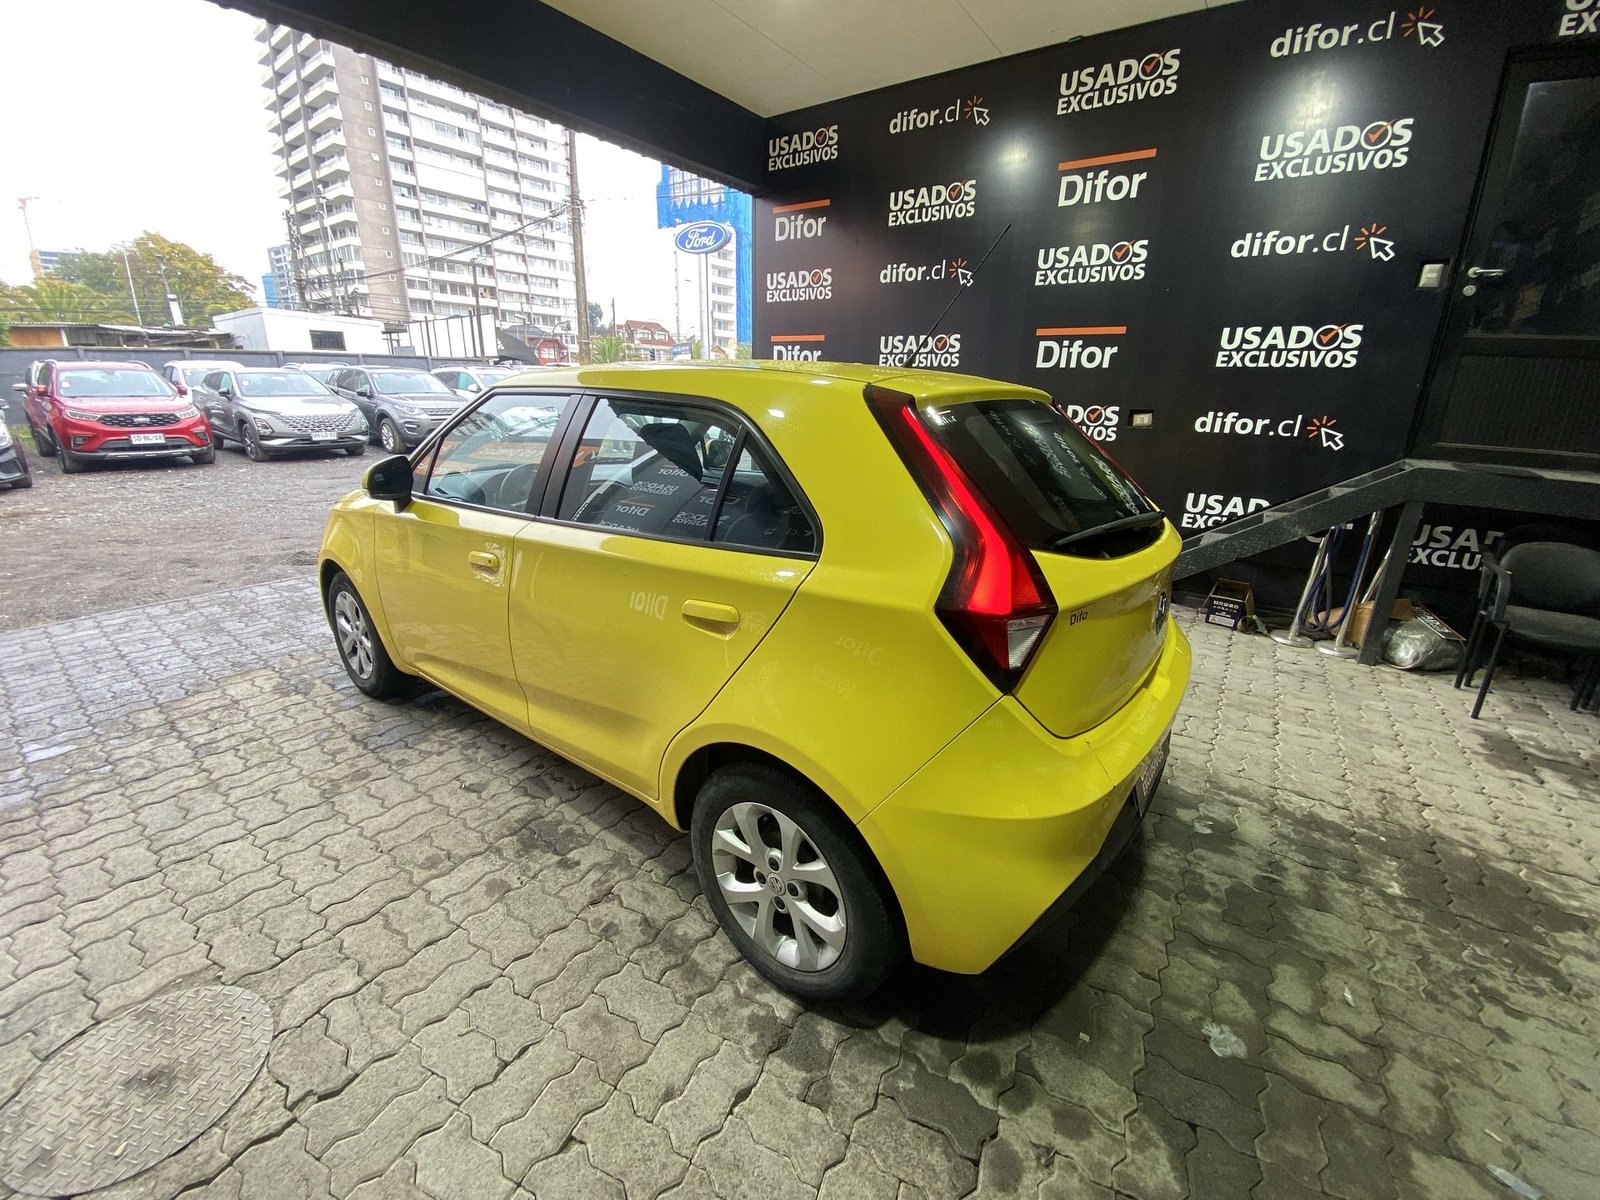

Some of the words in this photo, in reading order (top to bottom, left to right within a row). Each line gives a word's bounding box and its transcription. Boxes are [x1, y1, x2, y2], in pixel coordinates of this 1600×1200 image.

[1269, 11, 1397, 58] difor.cl
[1058, 48, 1181, 96] USADOS
[1056, 74, 1178, 116] EXCLUSIVOS
[888, 99, 961, 134] difor.cl
[768, 125, 838, 157] USADOS
[1258, 118, 1415, 161] USADOS
[768, 144, 838, 171] EXCLUSIVOS
[1254, 147, 1409, 182] EXCLUSIVOS
[889, 179, 976, 212] USADOS
[1057, 169, 1147, 207] Difor
[888, 201, 975, 227] EXCLUSIVOS
[685, 227, 715, 249] Ford
[774, 214, 827, 242] Difor
[1230, 225, 1350, 258] difor.cl
[1037, 239, 1149, 269] USADOS
[766, 267, 833, 290] USADOS
[879, 259, 947, 284] difor.cl
[1034, 263, 1146, 286] EXCLUSIVOS
[766, 285, 832, 303] EXCLUSIVOS
[879, 333, 961, 354] USADOS
[1219, 323, 1364, 350] USADOS
[772, 345, 822, 362] Difor
[879, 353, 960, 367] EXCUSIVOS
[1035, 339, 1118, 369] Difor
[1215, 349, 1359, 368] EXCLUSIVOS
[1057, 404, 1120, 426] DOS
[1194, 411, 1303, 438] difor.cl
[1412, 524, 1505, 552] USA
